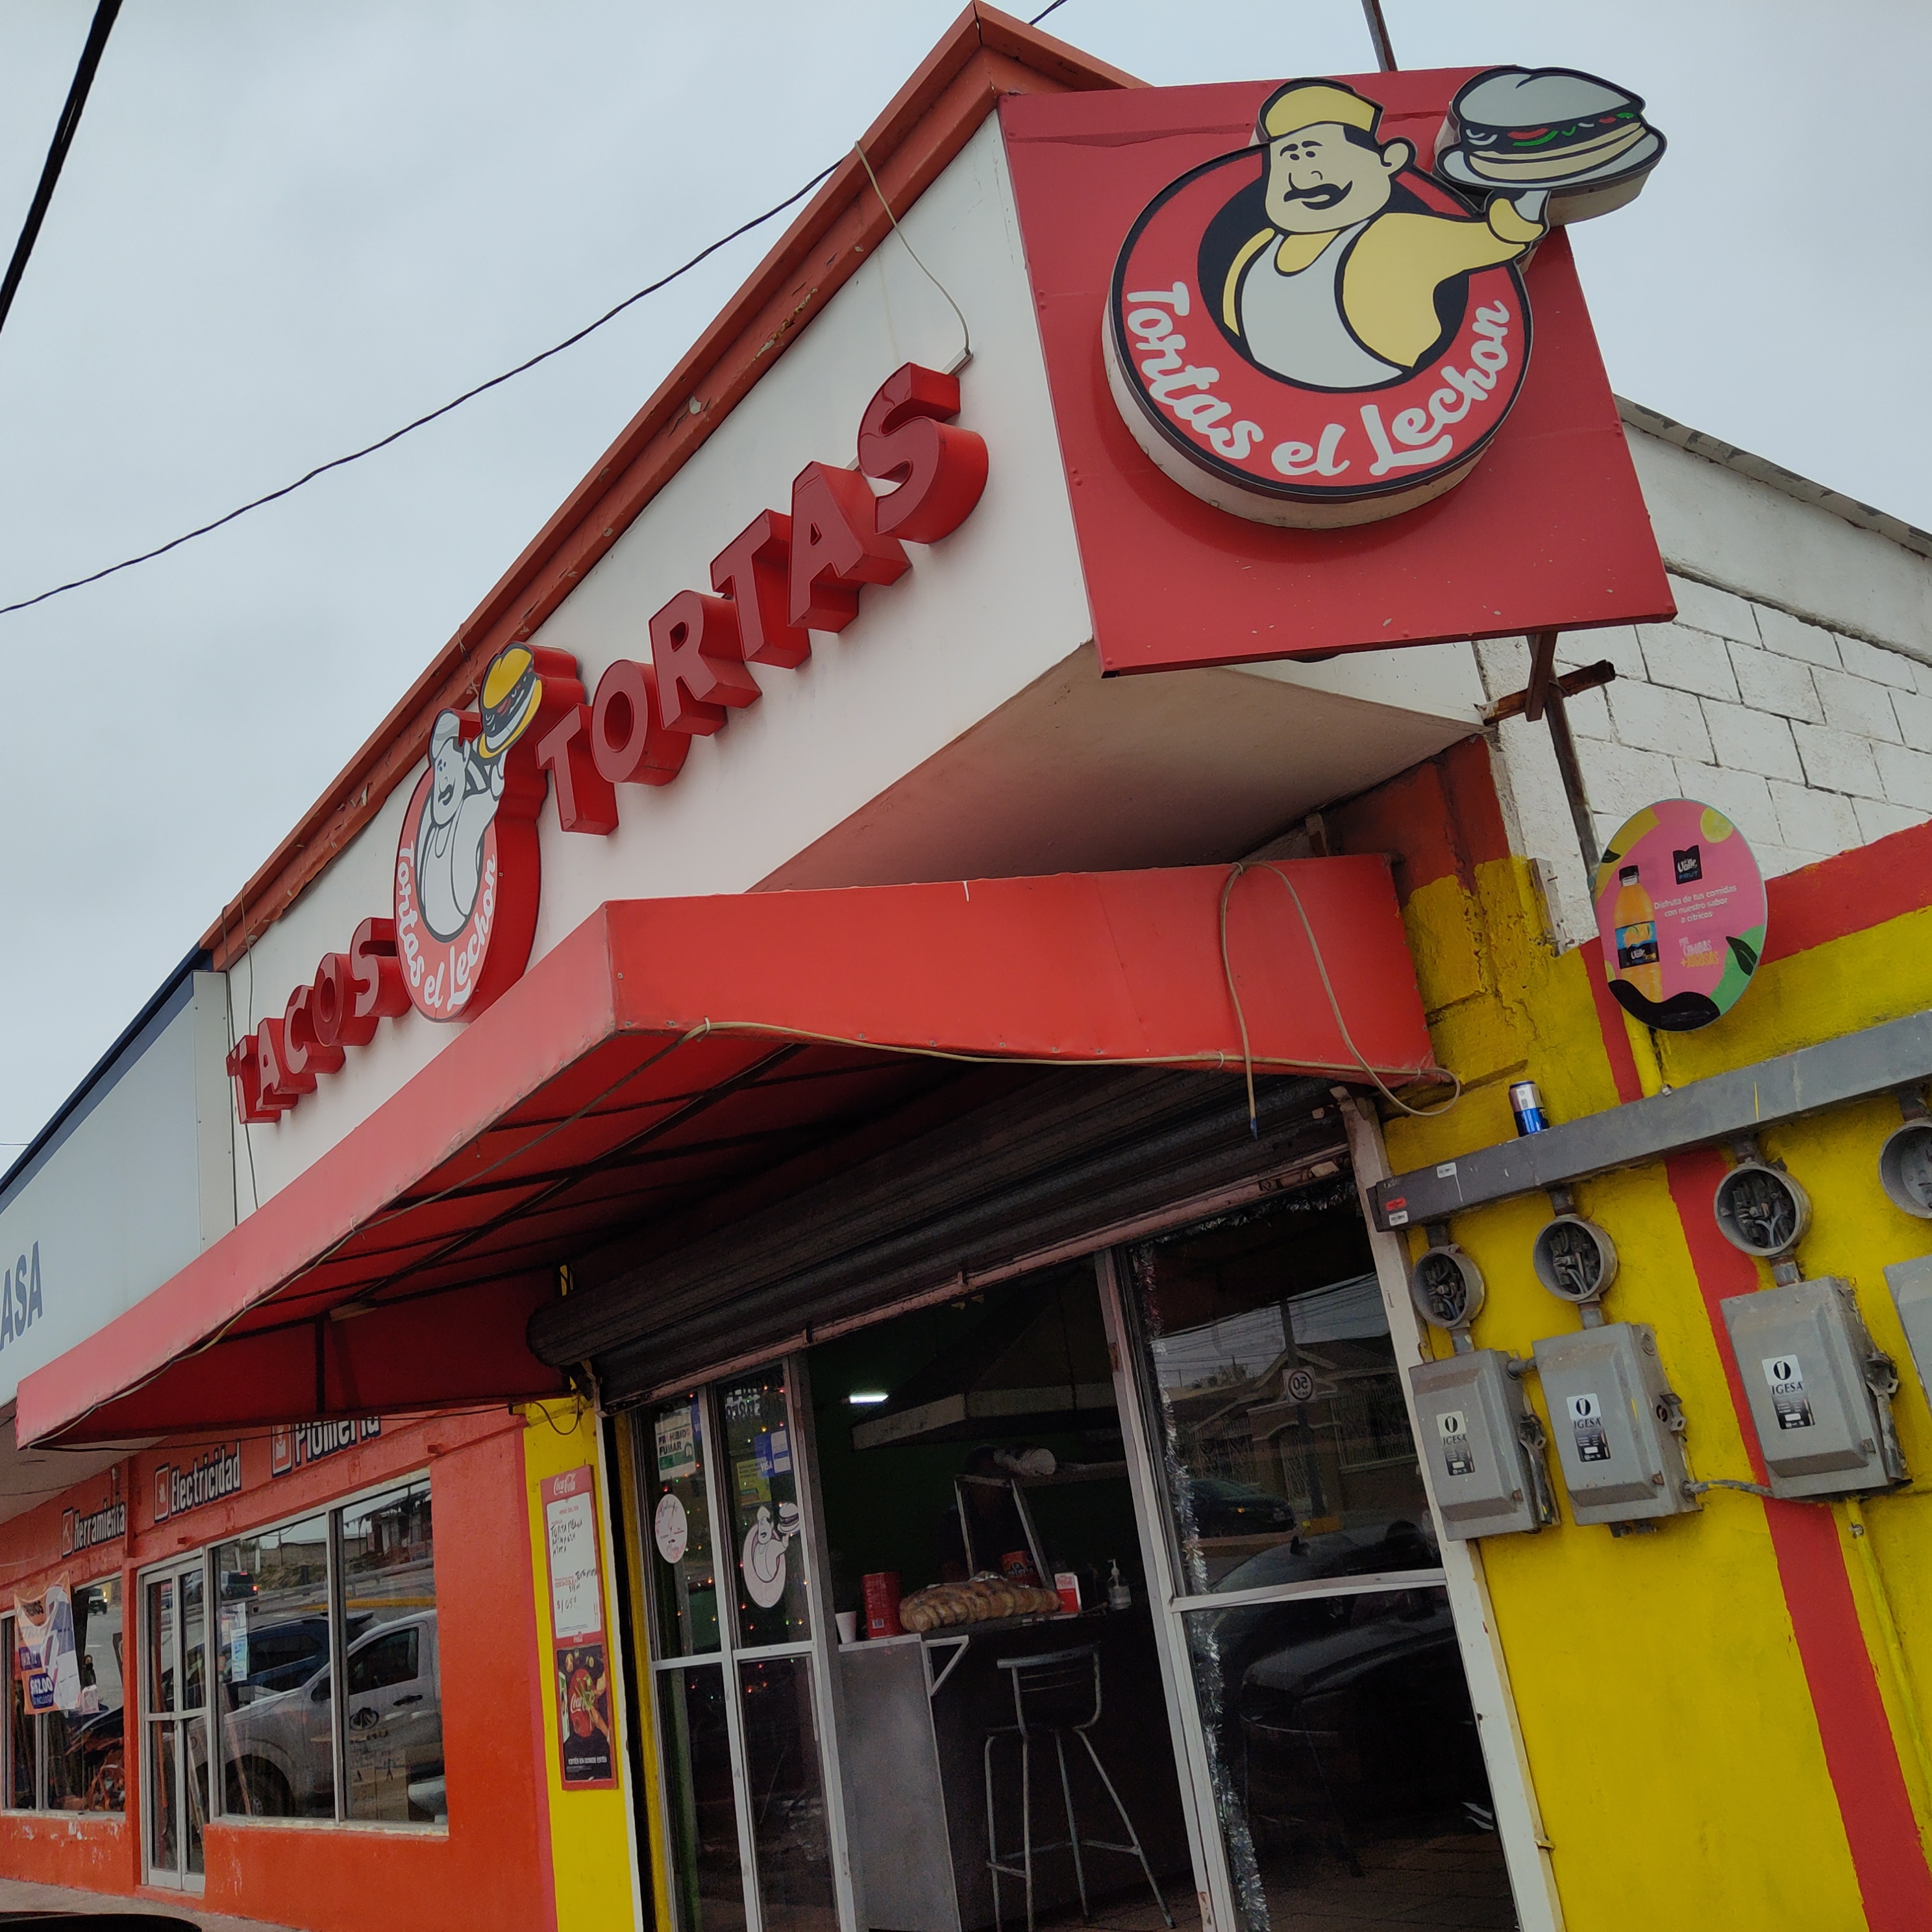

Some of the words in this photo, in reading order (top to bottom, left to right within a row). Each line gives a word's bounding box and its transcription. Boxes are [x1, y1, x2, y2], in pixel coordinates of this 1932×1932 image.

[1126, 281, 1264, 459] Tortas
[1271, 423, 1351, 476] el
[1360, 299, 1510, 476] Lechon
[536, 362, 989, 836] TORTAS
[1654, 898, 1681, 910] Disfruta
[1706, 886, 1737, 897] comidas
[1678, 902, 1706, 914] nuestro
[1707, 898, 1728, 908] sabor
[398, 840, 425, 987] Tortas
[424, 961, 445, 1008] el
[447, 854, 495, 1012] Lechon
[226, 917, 409, 1124] TACOS
[1772, 1381, 1803, 1395] IGESA
[1574, 1417, 1602, 1429] IGESA
[658, 1428, 690, 1444] PROHIBIDO
[1443, 1433, 1467, 1446] IGESA
[659, 1441, 682, 1456] FUMAR
[171, 1439, 242, 1514] Electricidad
[74, 1492, 126, 1552] Herramienta
